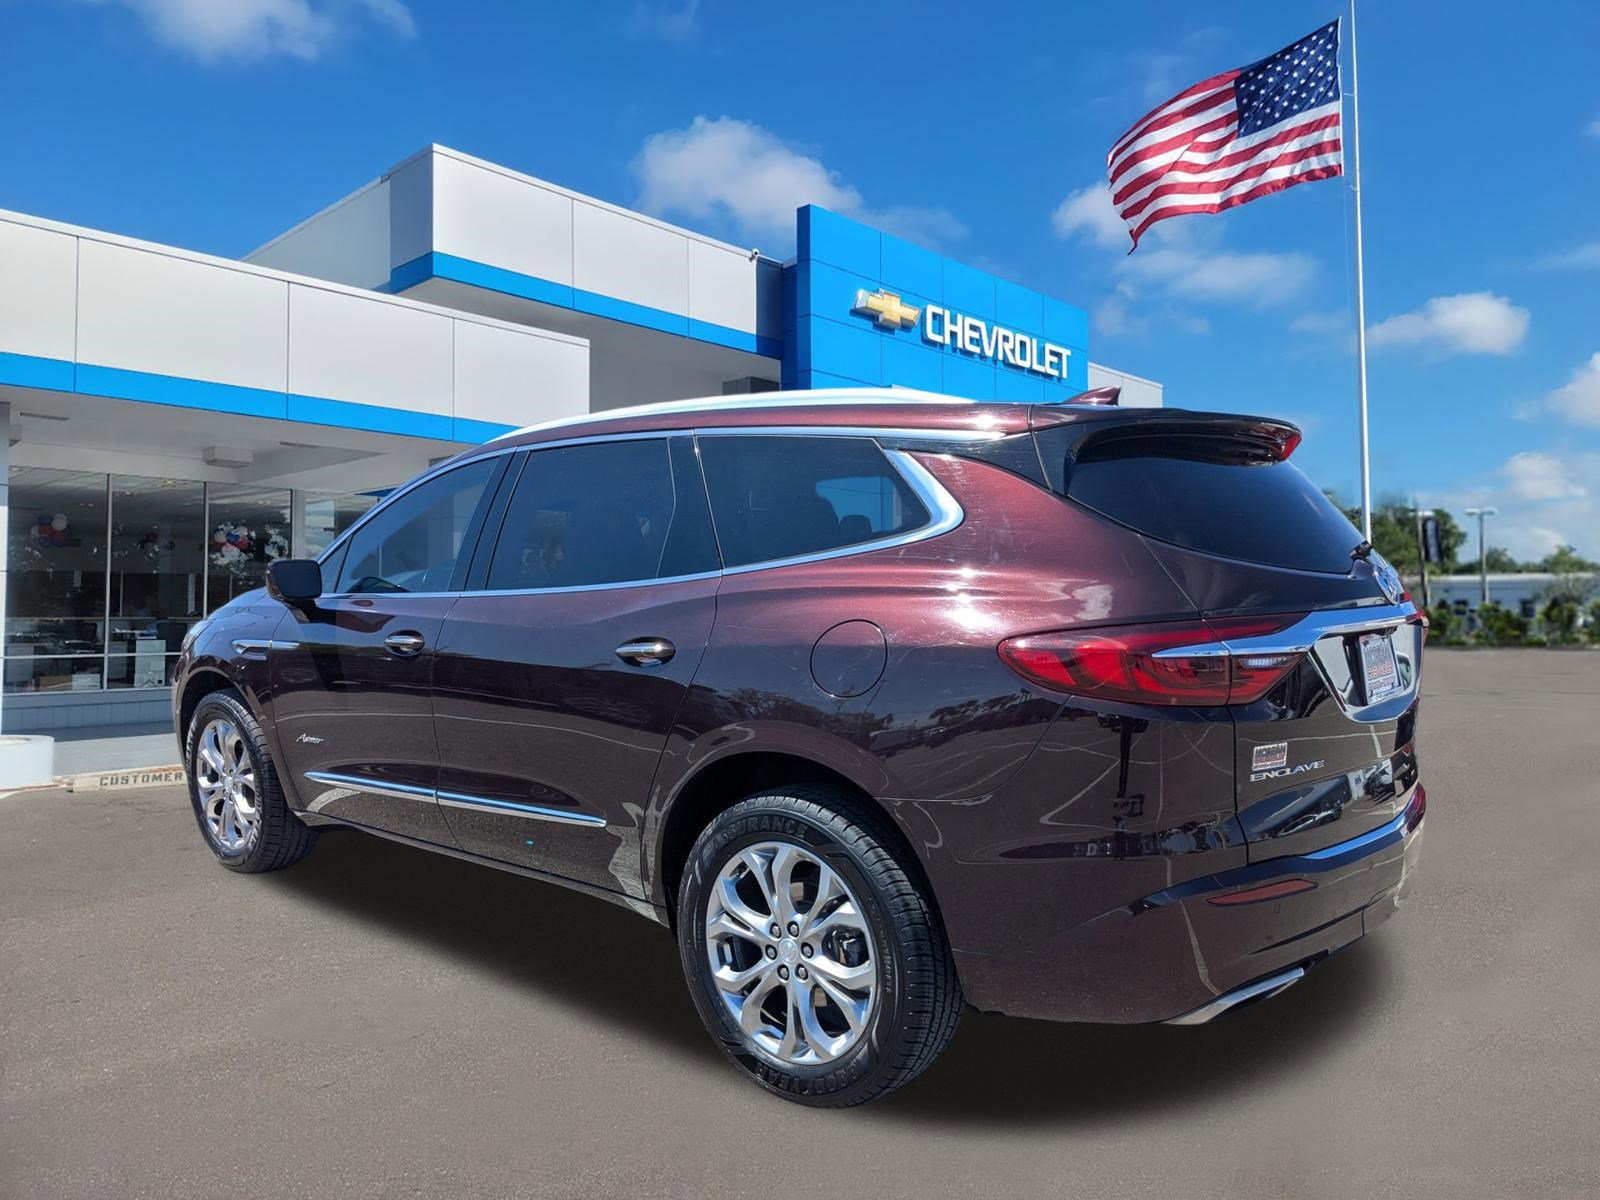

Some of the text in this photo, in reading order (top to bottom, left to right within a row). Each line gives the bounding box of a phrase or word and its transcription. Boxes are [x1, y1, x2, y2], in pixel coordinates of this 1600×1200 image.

[926, 304, 1072, 379] CHEVROLET
[99, 772, 183, 786] CUSTOMER
[1250, 760, 1326, 782] ENCLAVE
